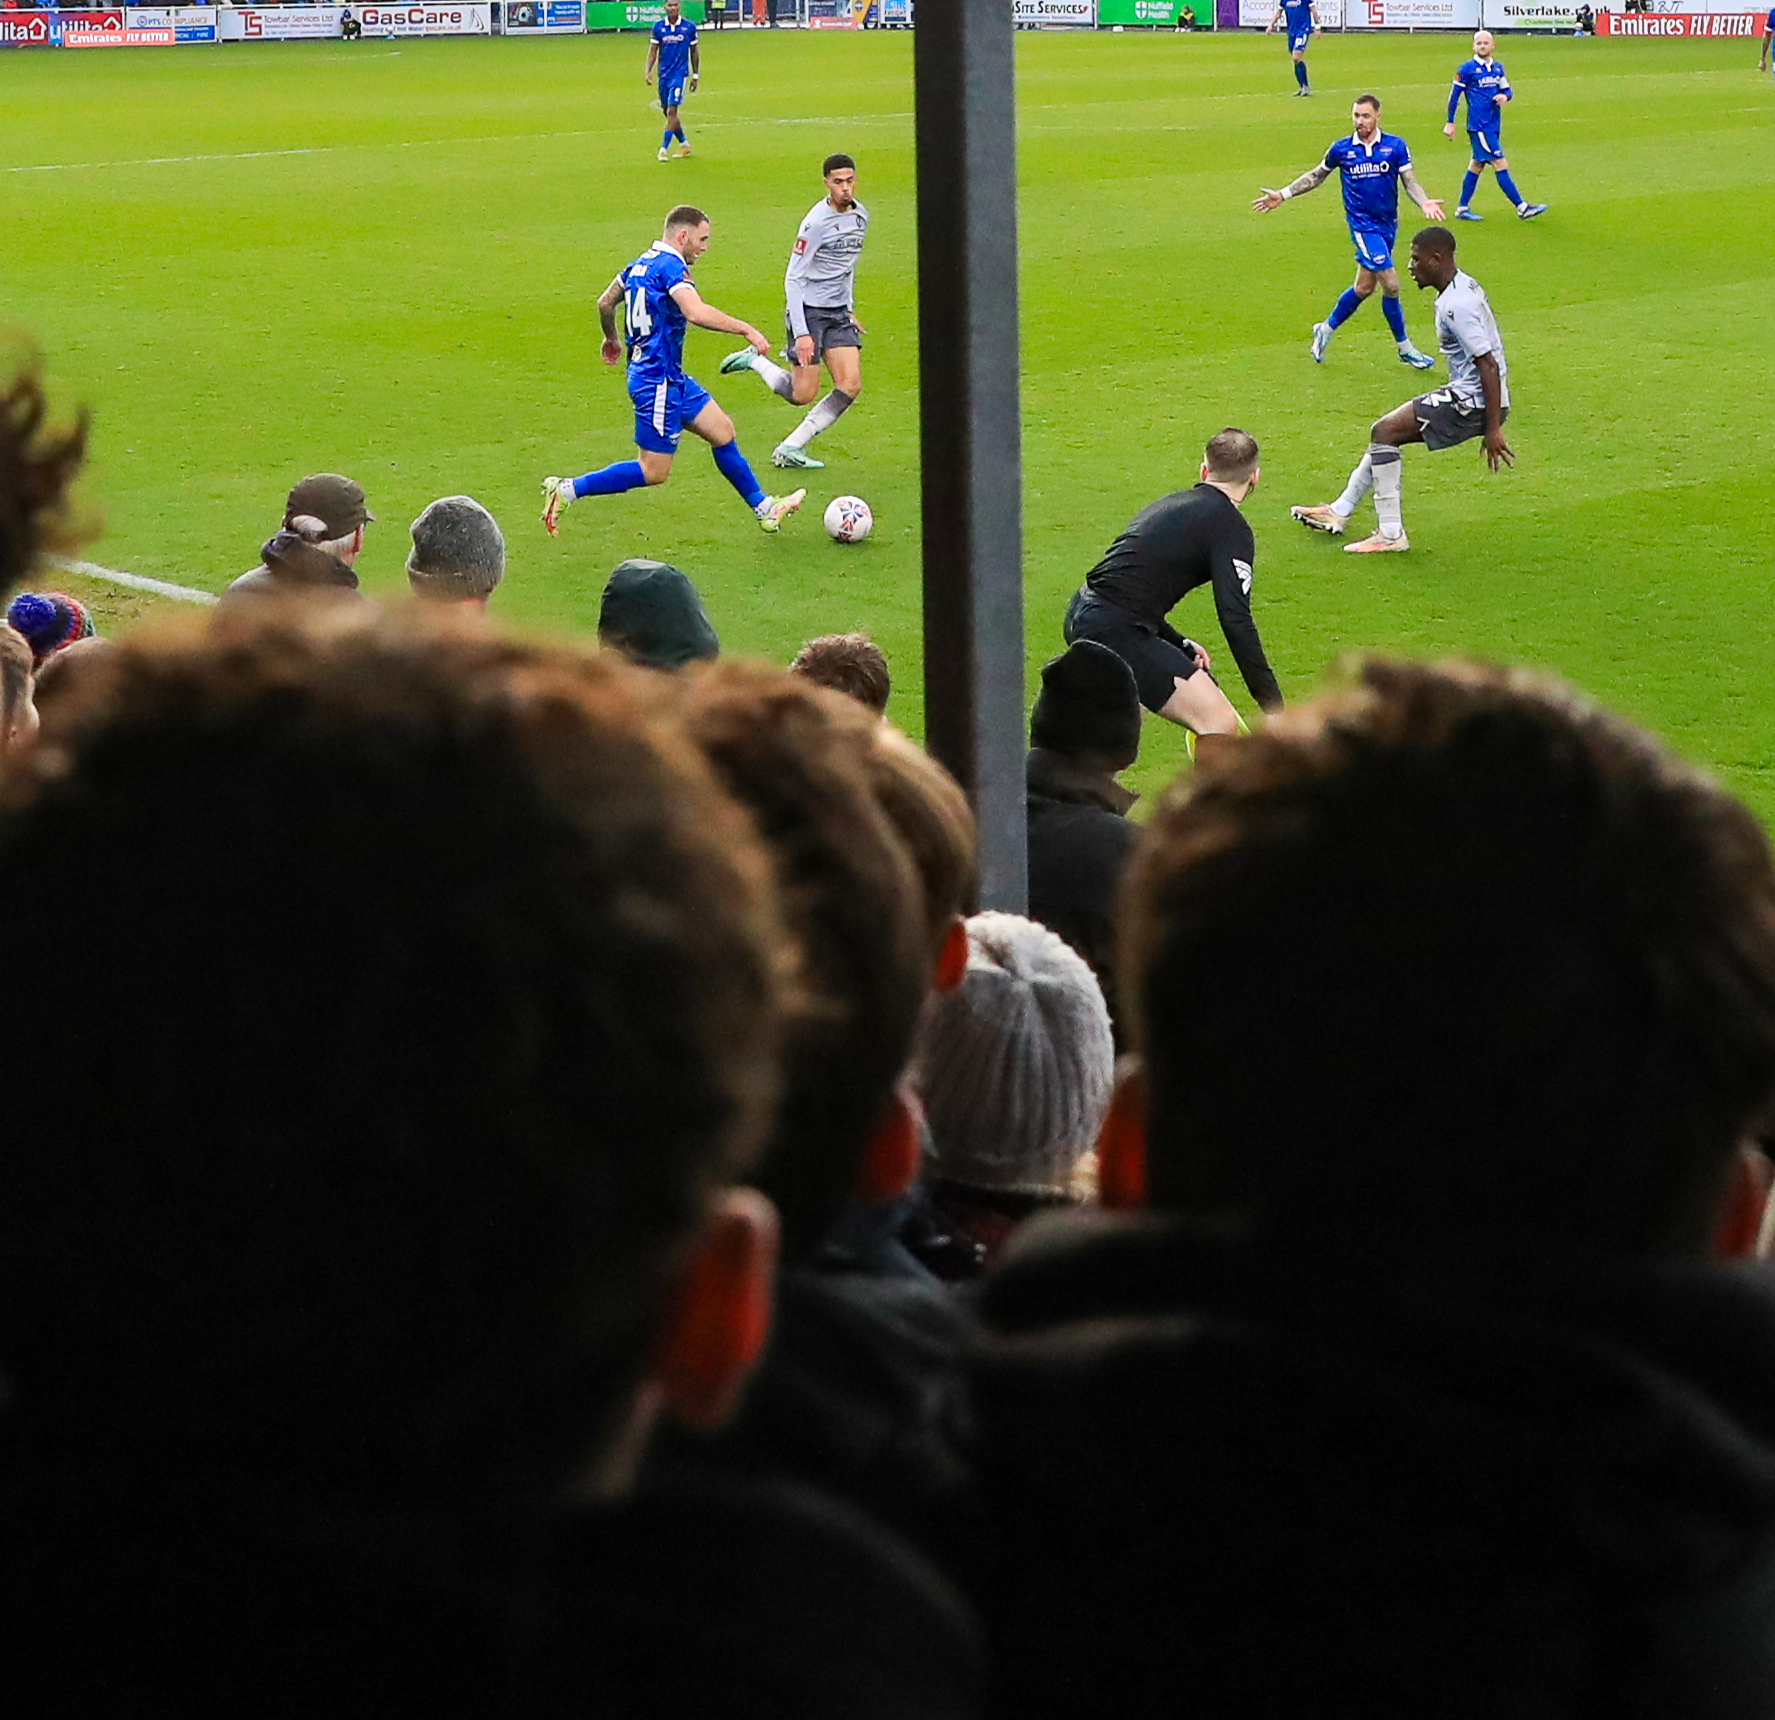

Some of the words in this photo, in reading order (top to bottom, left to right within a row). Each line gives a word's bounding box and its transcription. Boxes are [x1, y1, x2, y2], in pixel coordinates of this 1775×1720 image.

[1413, 2, 1439, 12] Services
[362, 9, 462, 25] GasCare
[1609, 16, 1685, 35] Emirates
[1690, 15, 1711, 35] FLY
[1712, 15, 1754, 35] BETTER
[69, 33, 122, 44] Emirates
[1350, 161, 1381, 175] utilita
[624, 286, 653, 338] 14
